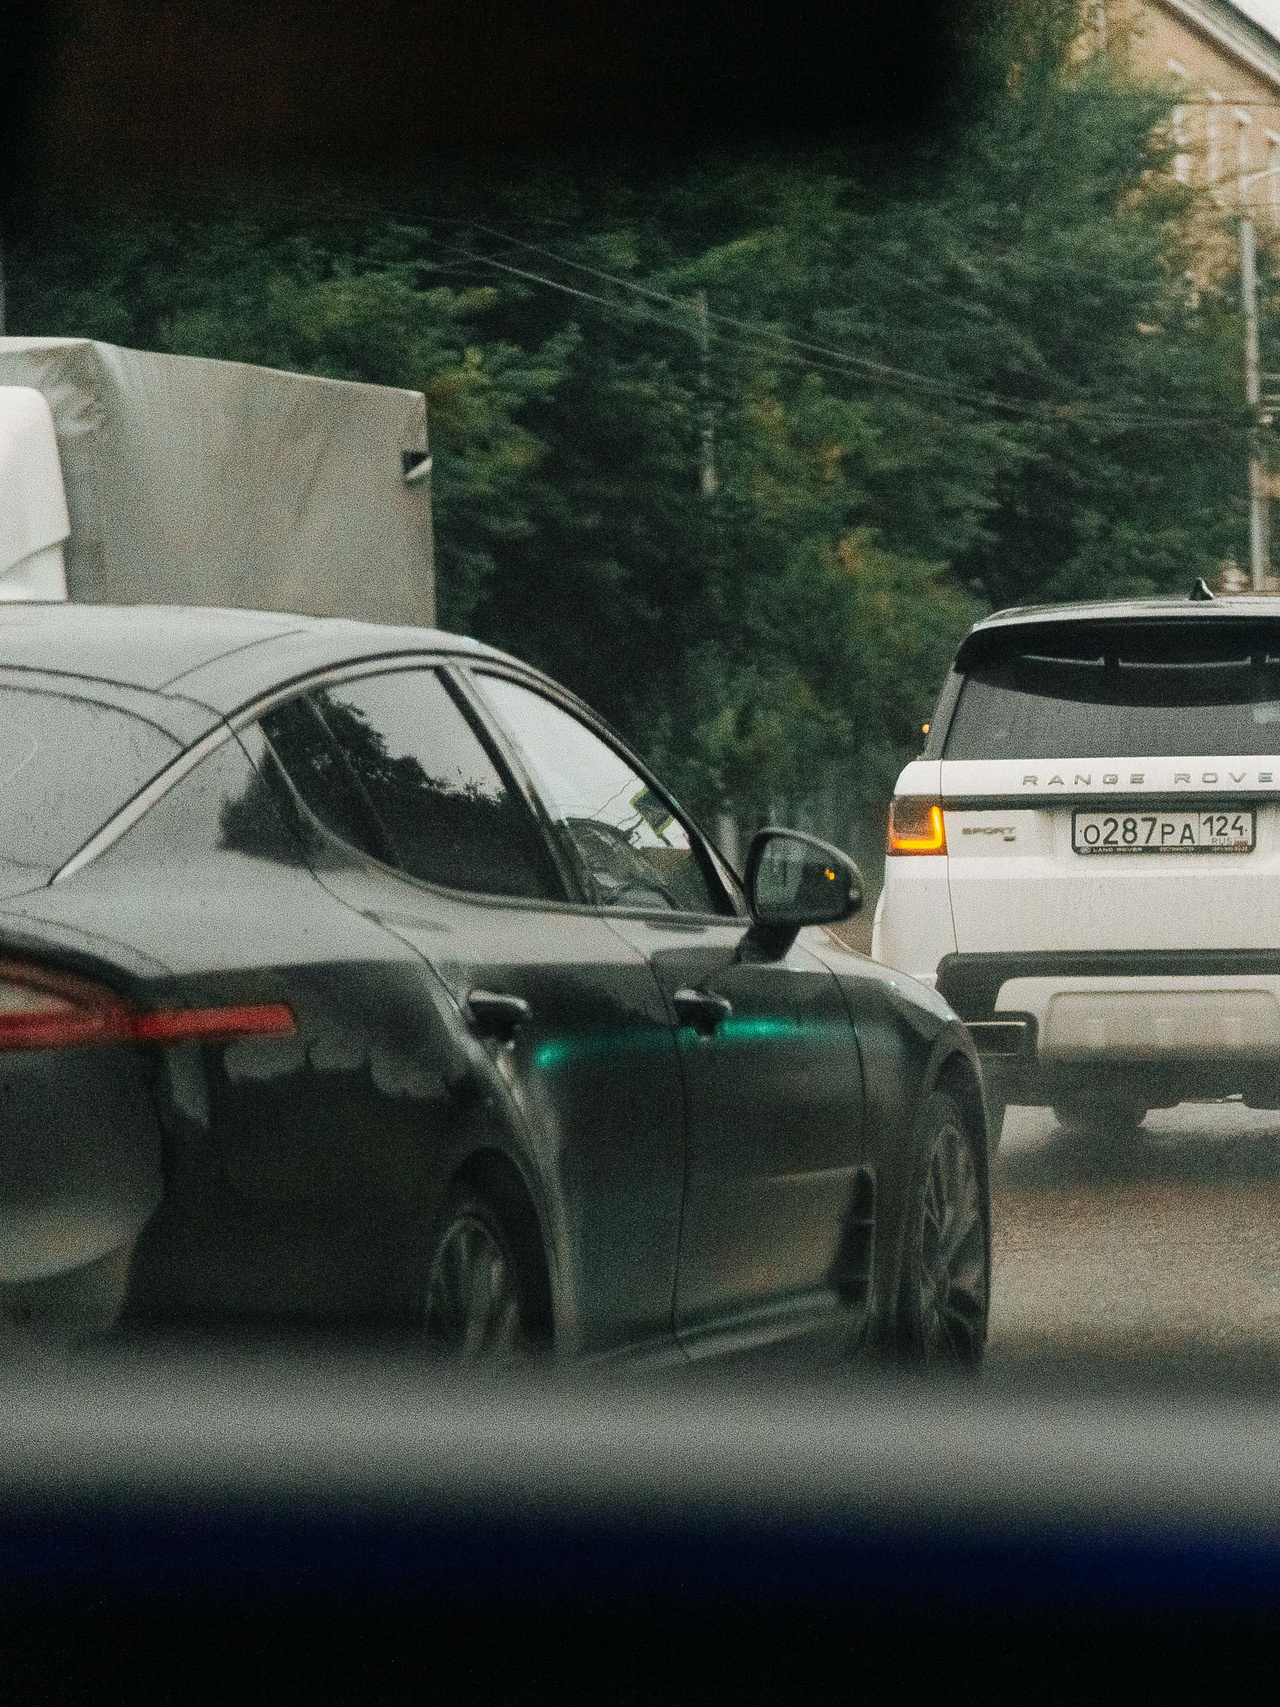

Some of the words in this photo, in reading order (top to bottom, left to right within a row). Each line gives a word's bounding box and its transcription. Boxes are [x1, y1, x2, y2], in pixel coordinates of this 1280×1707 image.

[1022, 773, 1146, 786] RANGE
[1203, 815, 1244, 837] 124
[1211, 837, 1233, 846] RUS
